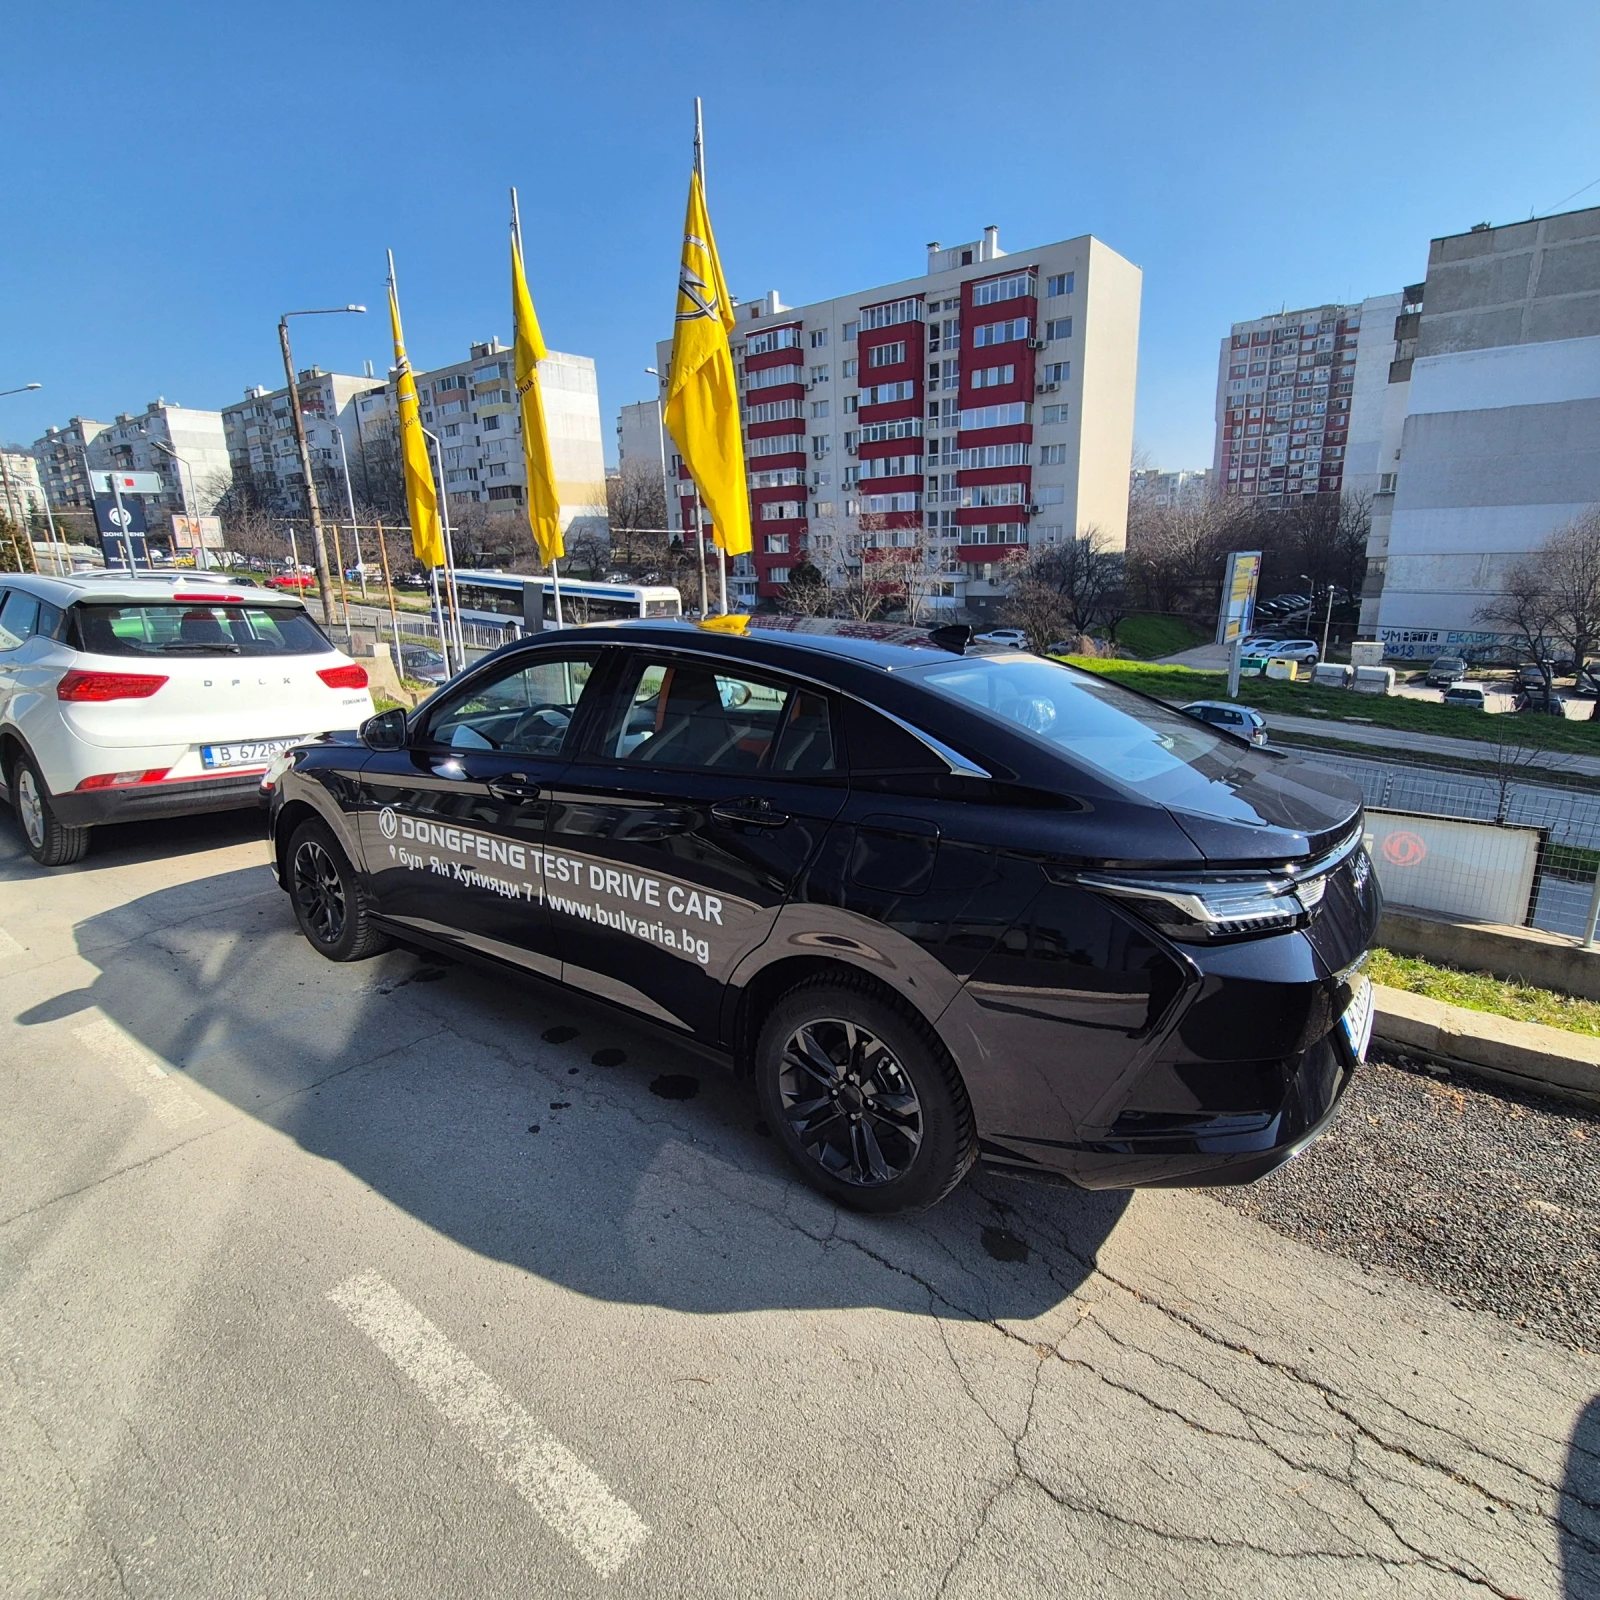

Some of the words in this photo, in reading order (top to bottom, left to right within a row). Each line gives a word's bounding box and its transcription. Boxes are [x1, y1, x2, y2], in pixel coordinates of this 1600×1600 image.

[220, 746, 232, 761] B
[399, 847, 424, 871] бул
[430, 856, 450, 878] Ян
[451, 861, 521, 899] Хунияди
[523, 882, 533, 902] 7
[547, 893, 710, 964] www.bulvaria.bg
[401, 817, 526, 870] DONGFENG
[531, 850, 583, 885] TEST
[590, 865, 661, 907] DRIVE
[667, 886, 723, 926] CAR
